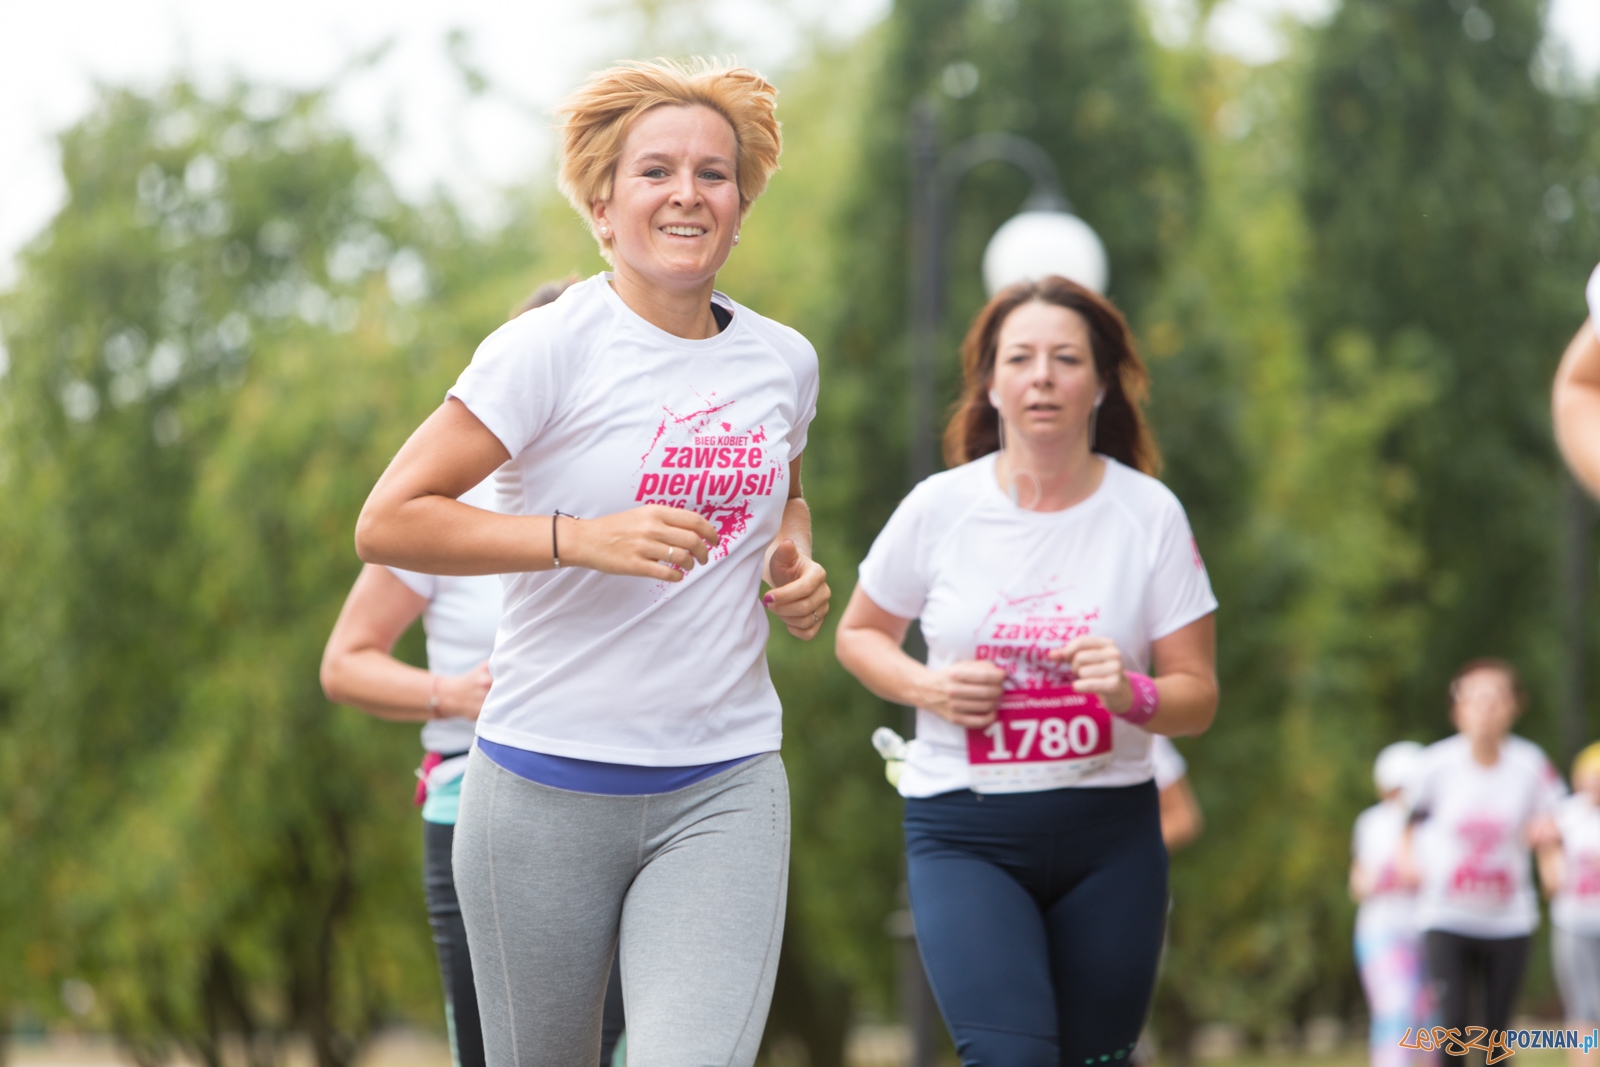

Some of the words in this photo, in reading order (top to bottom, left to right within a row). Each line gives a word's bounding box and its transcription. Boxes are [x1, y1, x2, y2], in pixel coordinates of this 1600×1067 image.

[695, 436, 716, 446] BIEG
[717, 436, 748, 446] KOBIET
[661, 446, 762, 469] zawsze
[635, 467, 776, 505] pier(w)si!
[984, 715, 1099, 760] 1780
